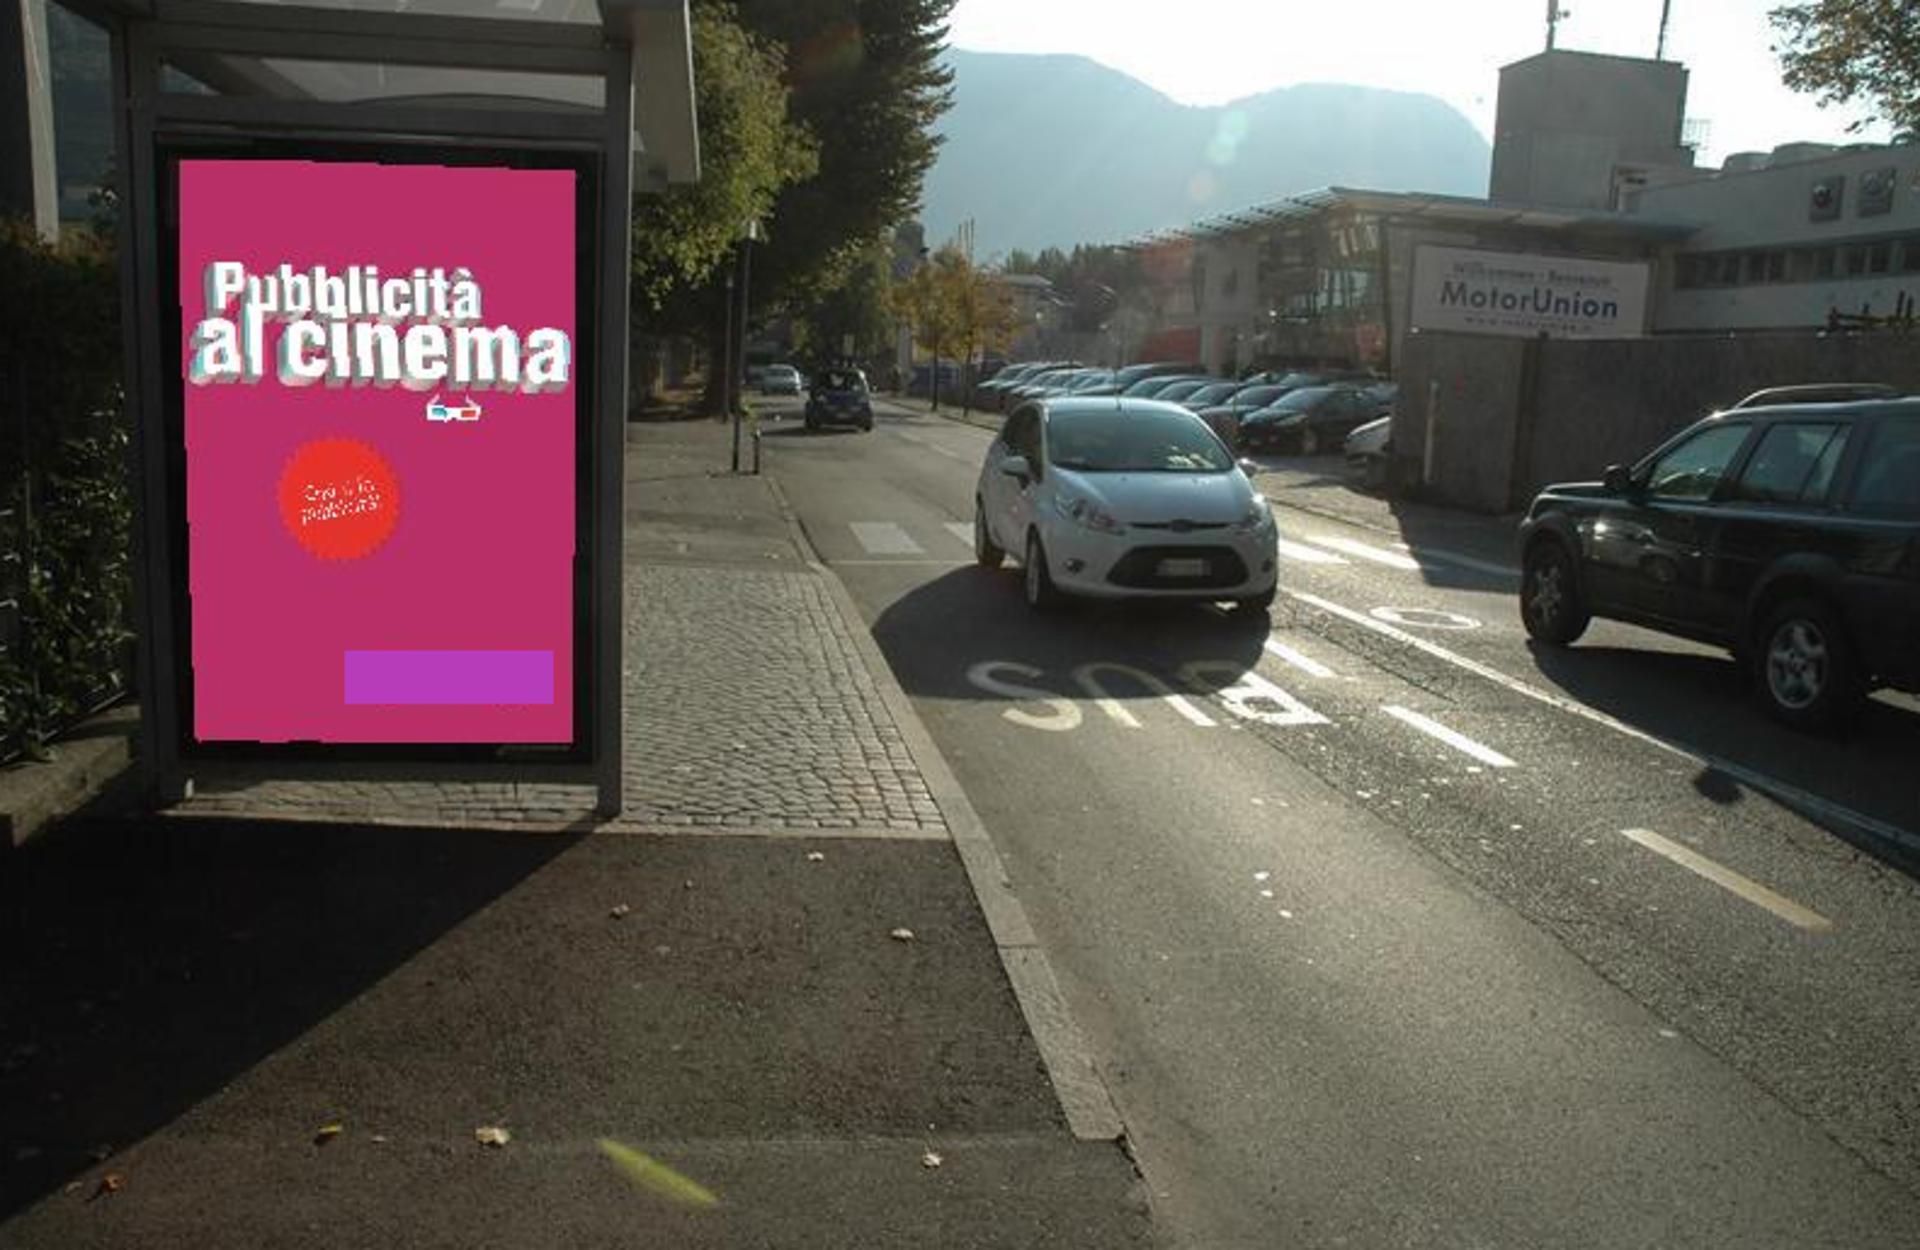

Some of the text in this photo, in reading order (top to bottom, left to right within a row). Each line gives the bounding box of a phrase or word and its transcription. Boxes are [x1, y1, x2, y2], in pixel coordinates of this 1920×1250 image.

[206, 261, 482, 321] Pubblicità
[1440, 280, 1619, 319] MotorUnion
[190, 302, 571, 394] al cinema
